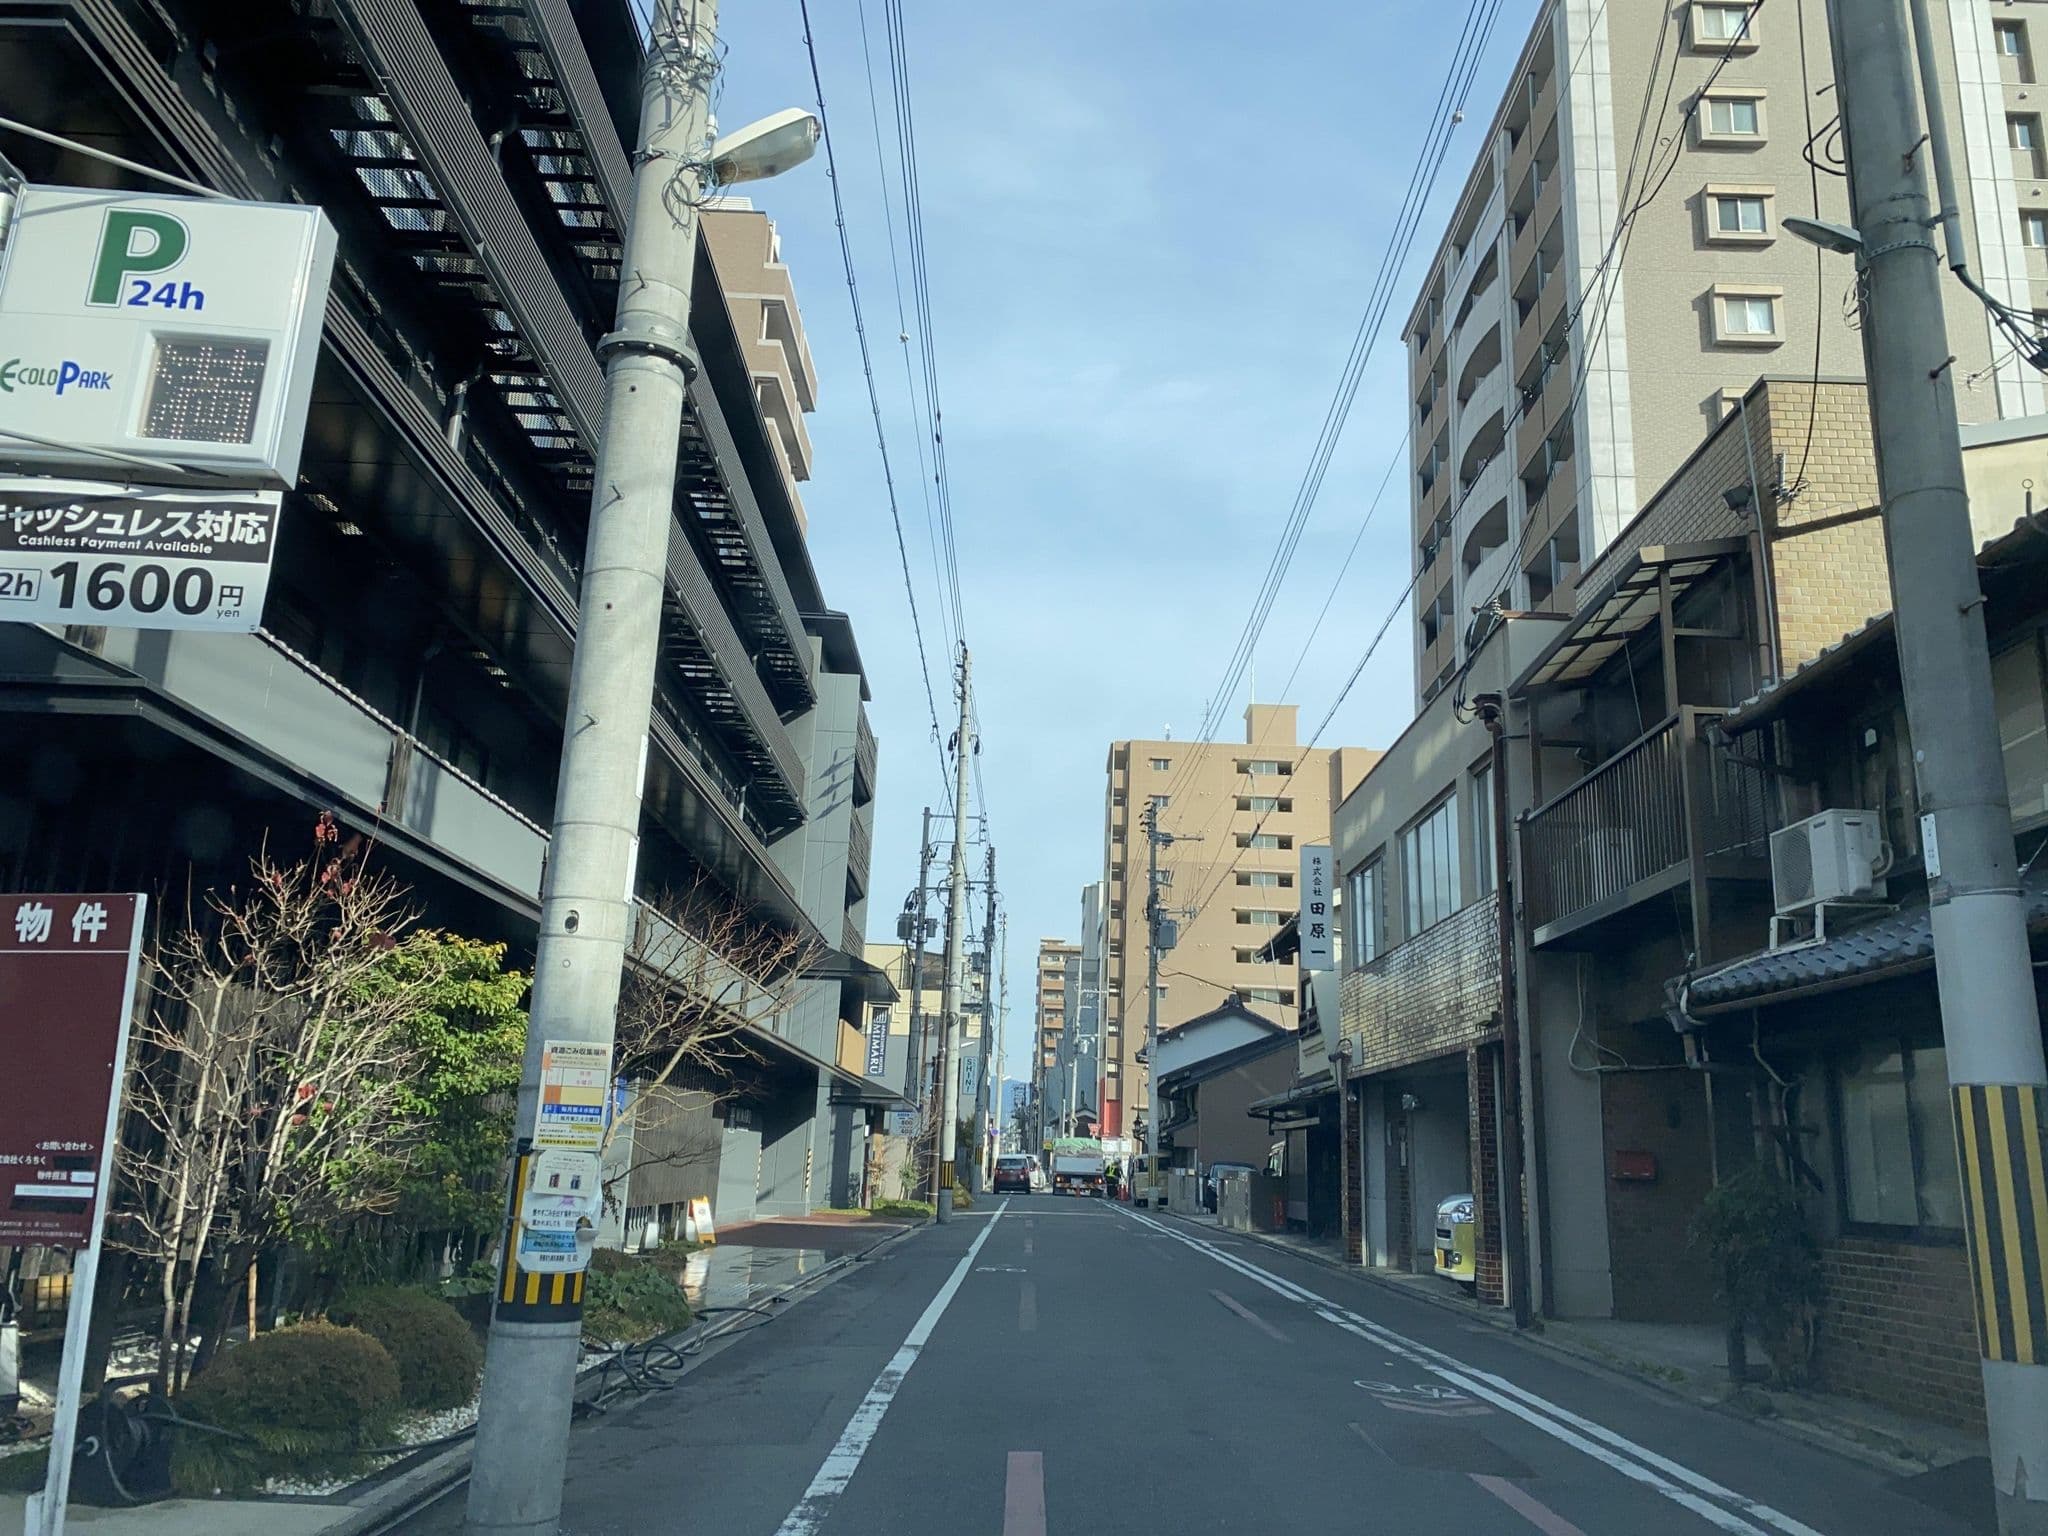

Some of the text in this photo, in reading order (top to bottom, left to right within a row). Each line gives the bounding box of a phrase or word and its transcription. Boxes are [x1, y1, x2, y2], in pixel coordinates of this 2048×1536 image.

[86, 206, 190, 308] P
[127, 279, 205, 311] 24h
[0, 504, 269, 544] ャッシュレス対応
[18, 534, 213, 554] Cashless Payment Available
[216, 608, 240, 618] yen
[15, 902, 108, 944] 物件
[869, 1024, 881, 1074] MIMARU
